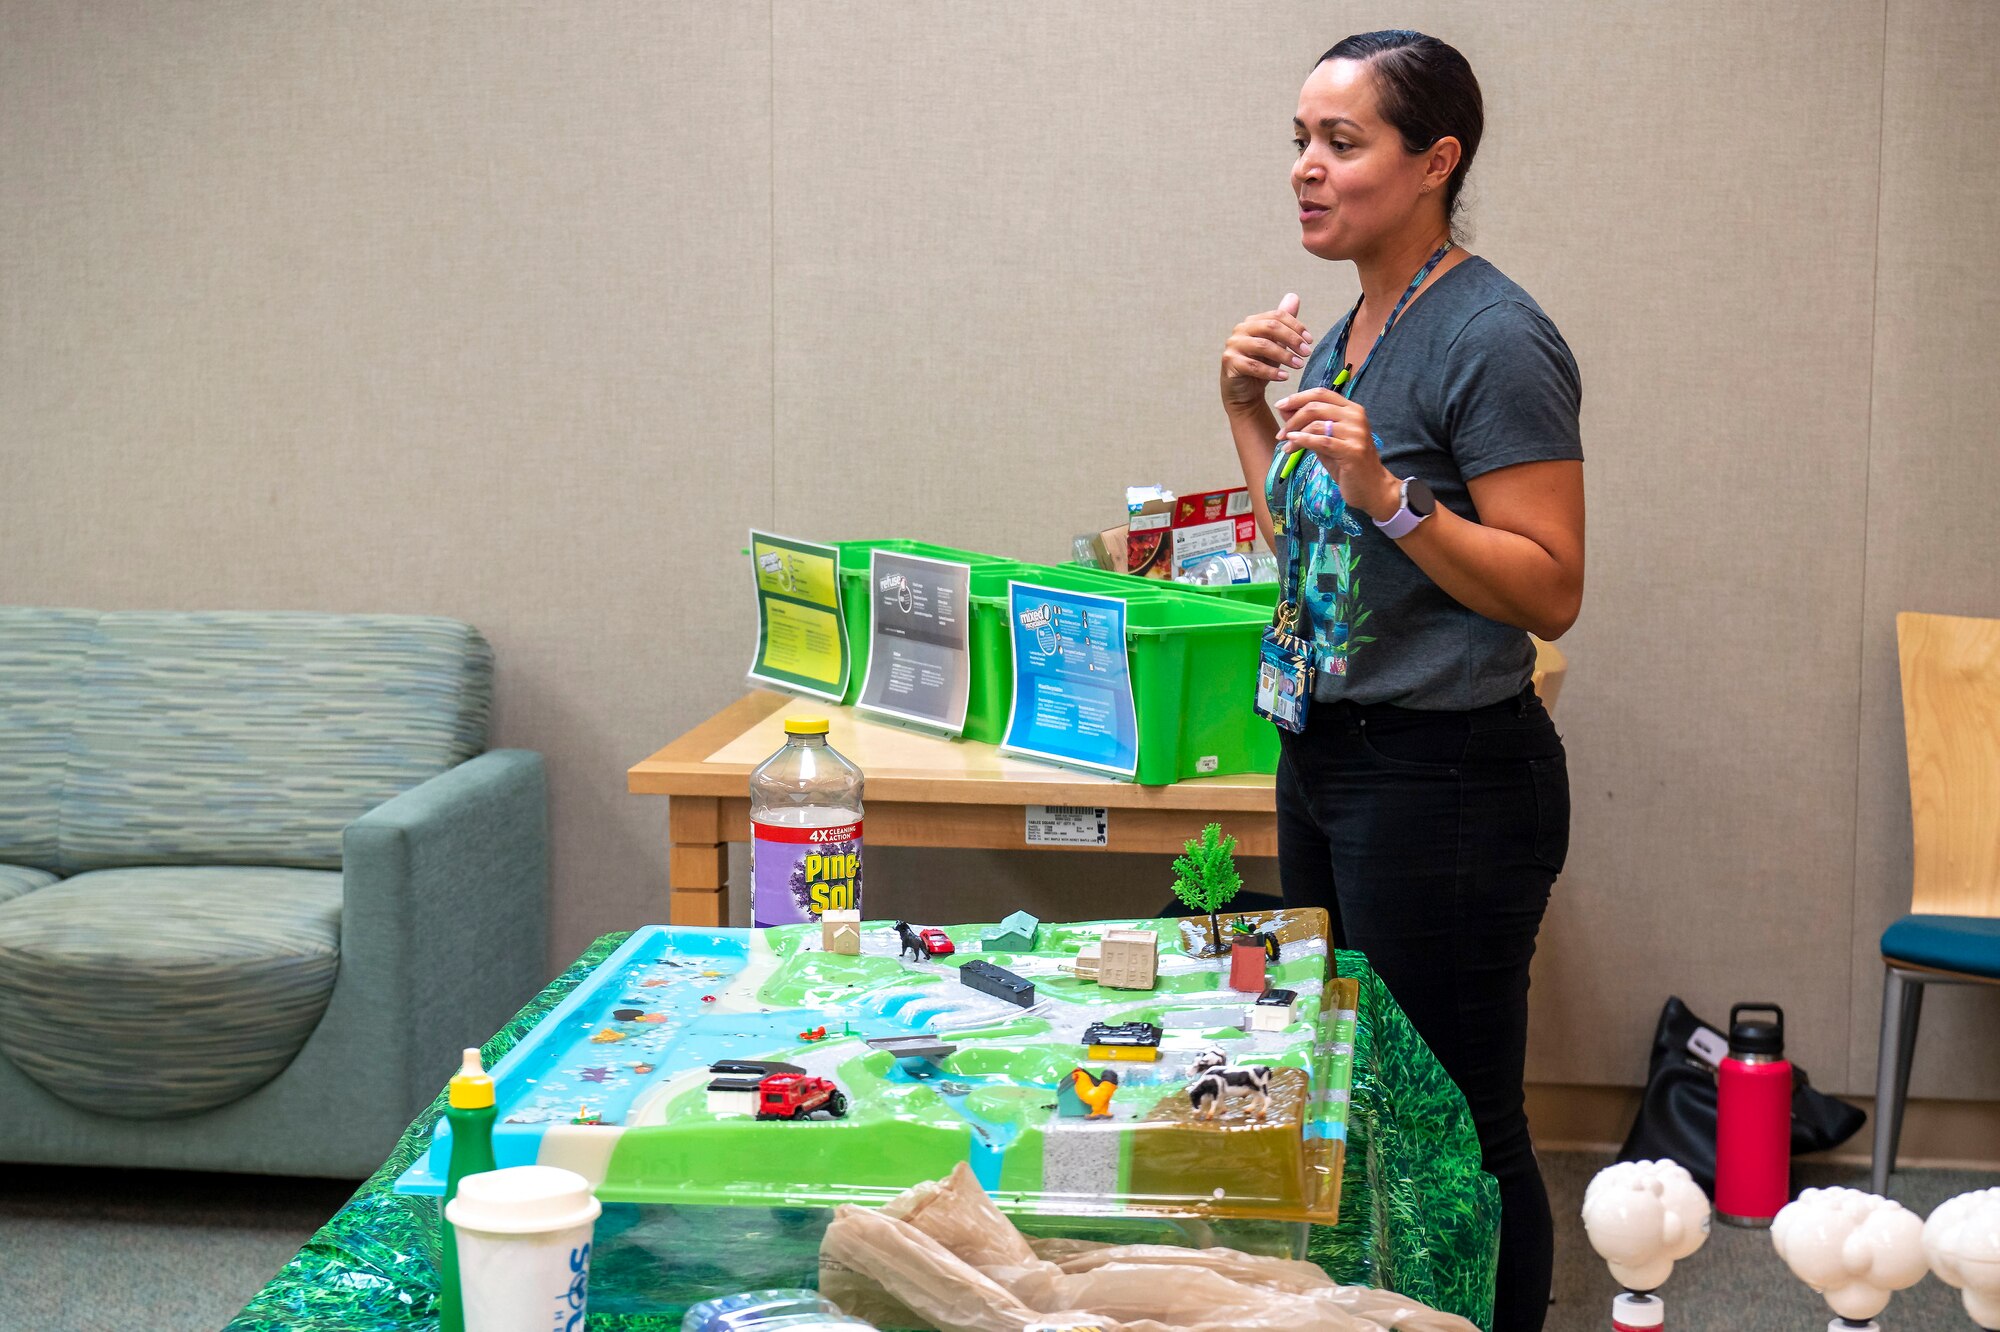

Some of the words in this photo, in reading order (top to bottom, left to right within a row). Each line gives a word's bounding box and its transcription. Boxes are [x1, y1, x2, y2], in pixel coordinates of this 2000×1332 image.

[880, 574, 901, 592] refuse
[1019, 606, 1044, 624] mixed
[809, 829, 829, 842] 4X
[829, 826, 856, 835] CLEANING
[811, 879, 854, 914] Sol
